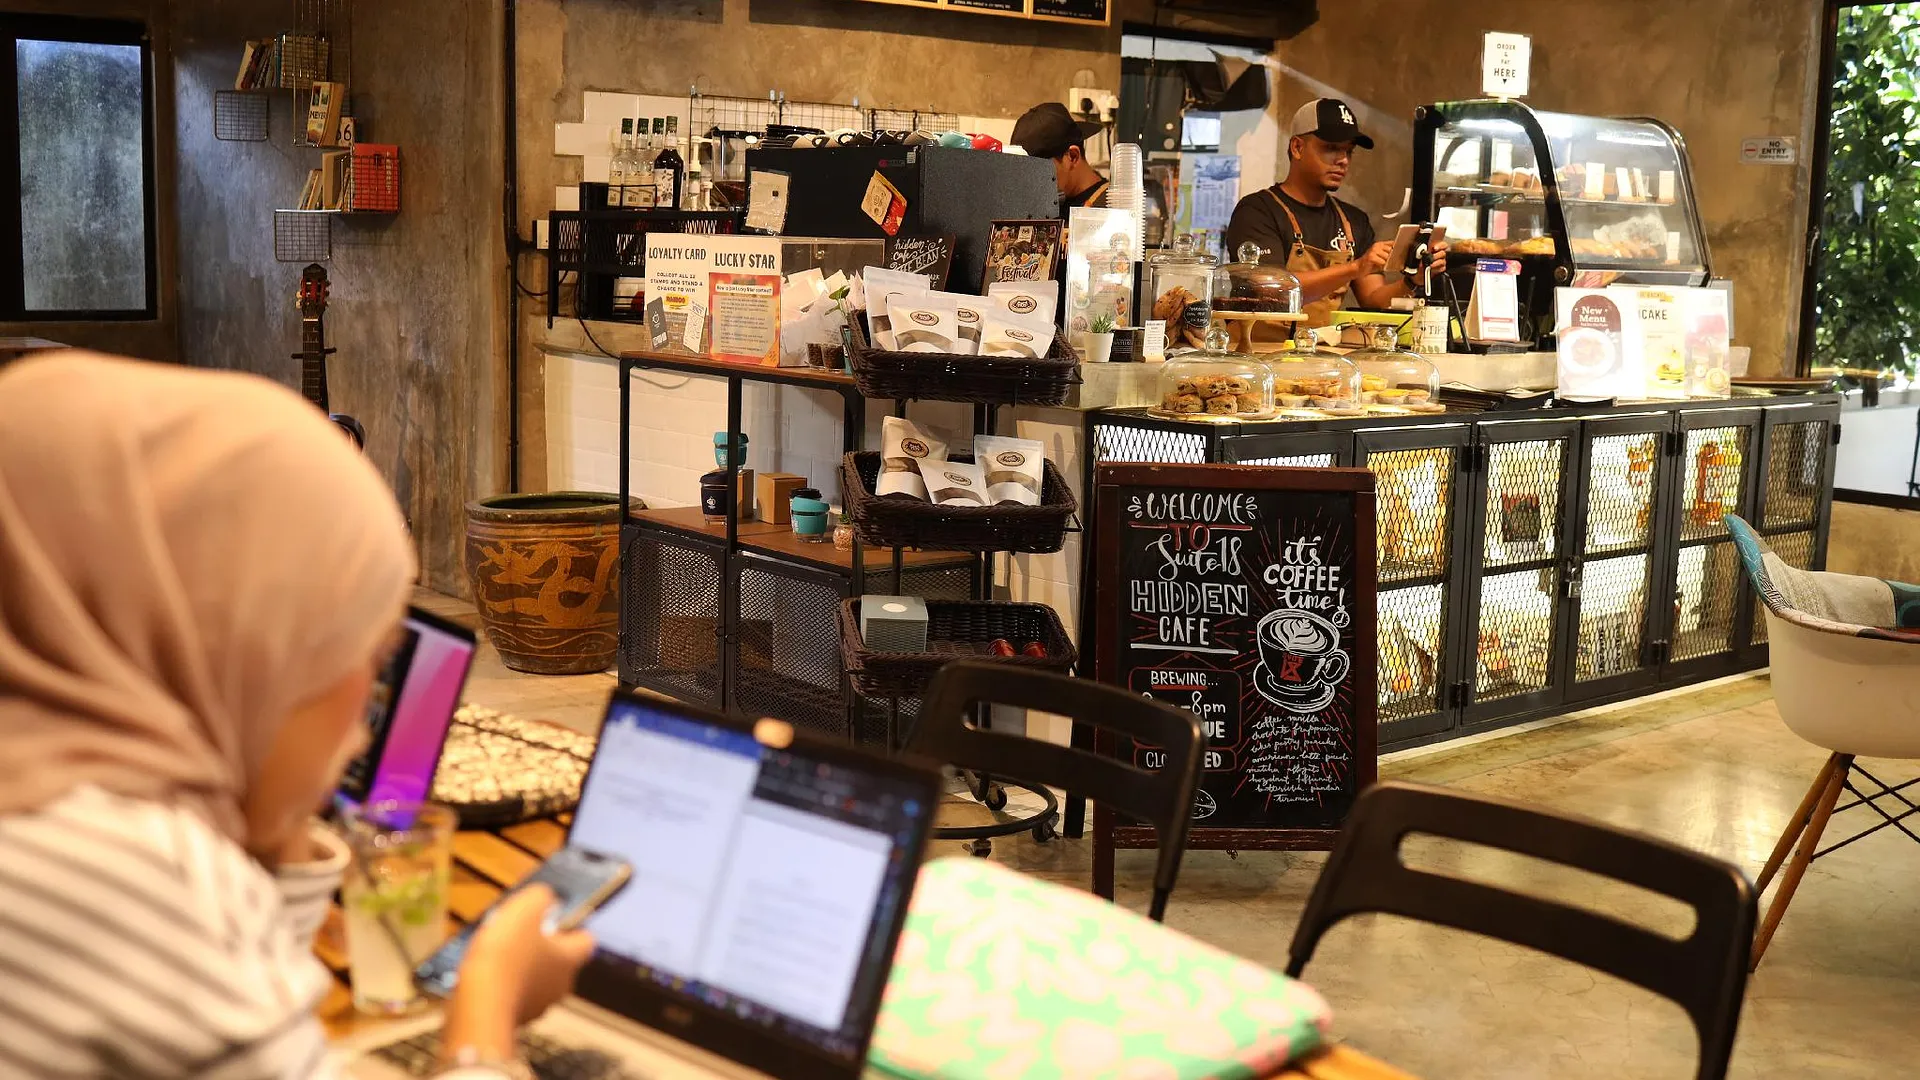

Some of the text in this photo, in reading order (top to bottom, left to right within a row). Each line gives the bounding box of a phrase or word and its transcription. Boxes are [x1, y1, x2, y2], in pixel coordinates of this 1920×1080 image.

[1493, 67, 1517, 78] HERE
[1338, 105, 1355, 125] LA
[1761, 147, 1787, 155] ENTRY
[1768, 140, 1781, 148] NO
[648, 247, 707, 261] LOYALTY CARD
[714, 252, 775, 270] LUCKY STAR
[1579, 314, 1606, 323] Menu
[1581, 305, 1603, 315] New
[1146, 492, 1246, 524] WELCOME
[1168, 522, 1211, 551] TO
[1283, 536, 1322, 567] it's
[1263, 563, 1341, 592] COFFEE
[1131, 580, 1248, 617] HIDDEN
[1159, 616, 1211, 646] CAFE
[1150, 670, 1219, 687] BREWING...
